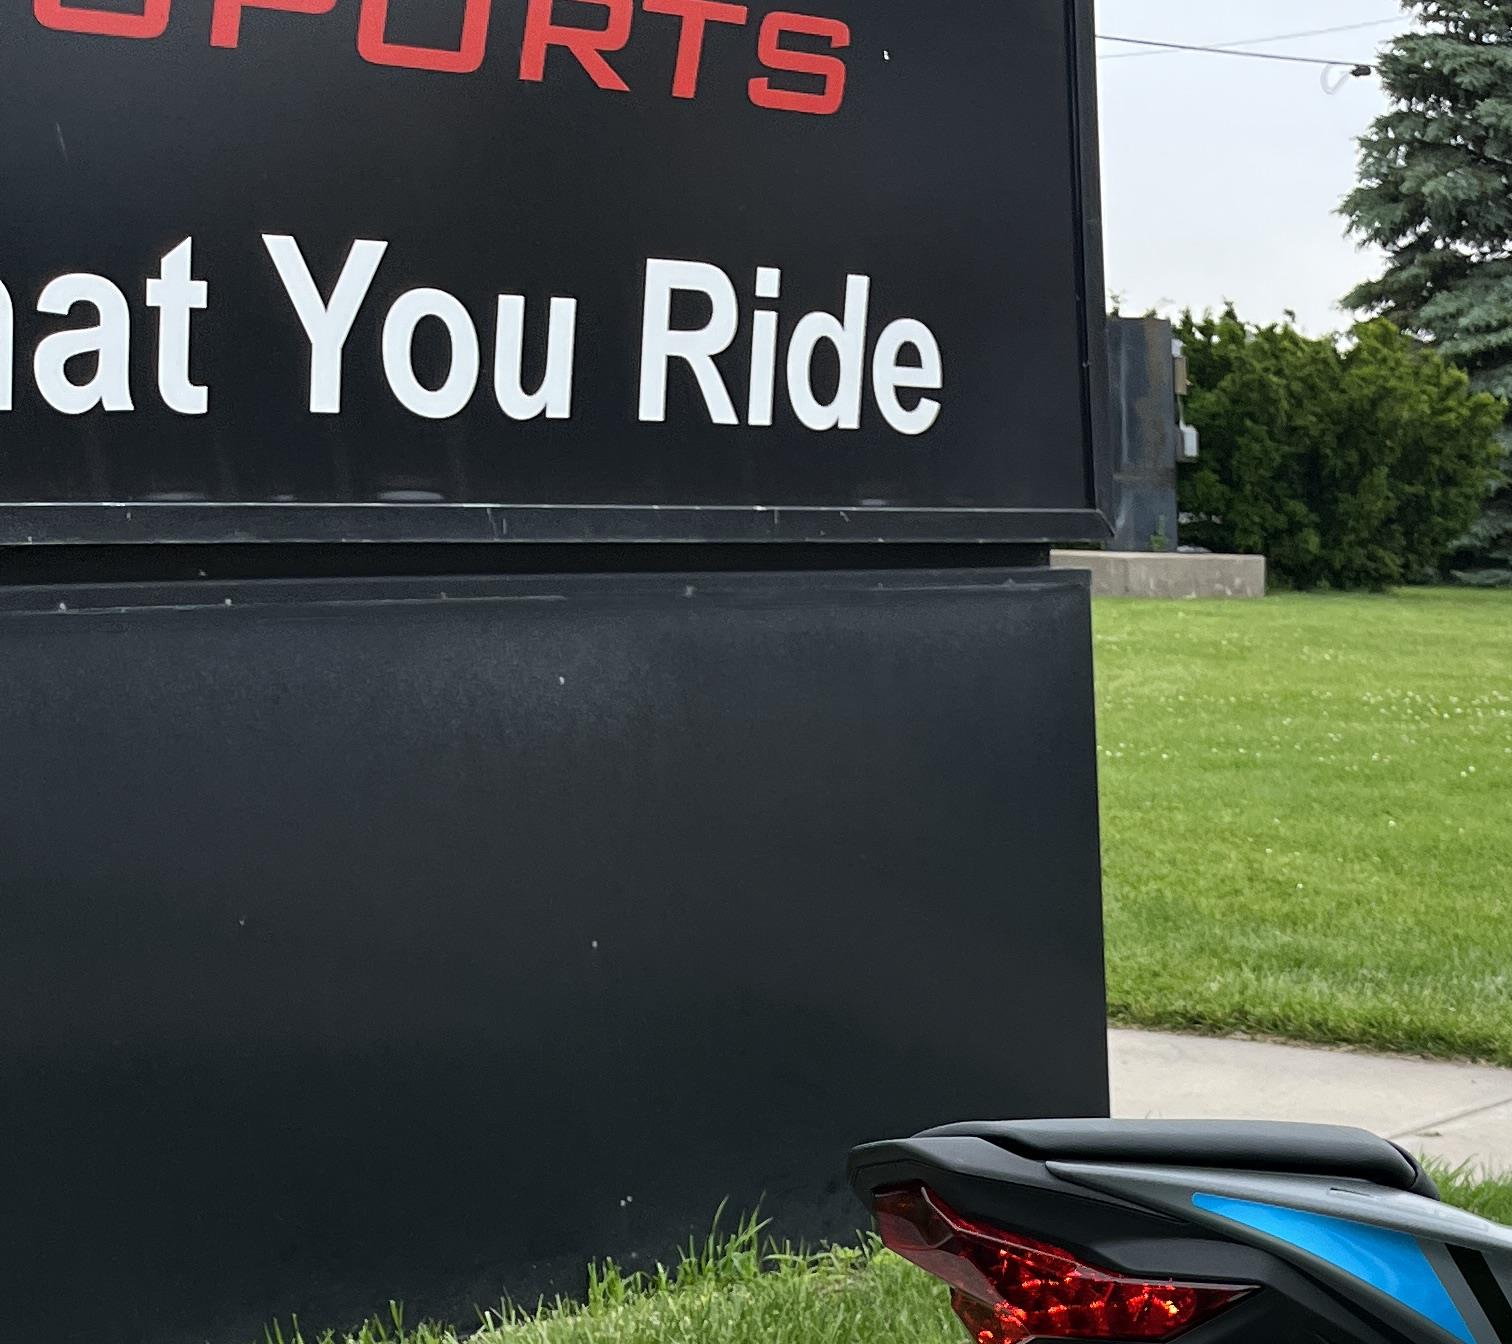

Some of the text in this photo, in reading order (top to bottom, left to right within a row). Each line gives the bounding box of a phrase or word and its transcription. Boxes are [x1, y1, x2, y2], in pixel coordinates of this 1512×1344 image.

[0, 233, 944, 436] at You Ride
